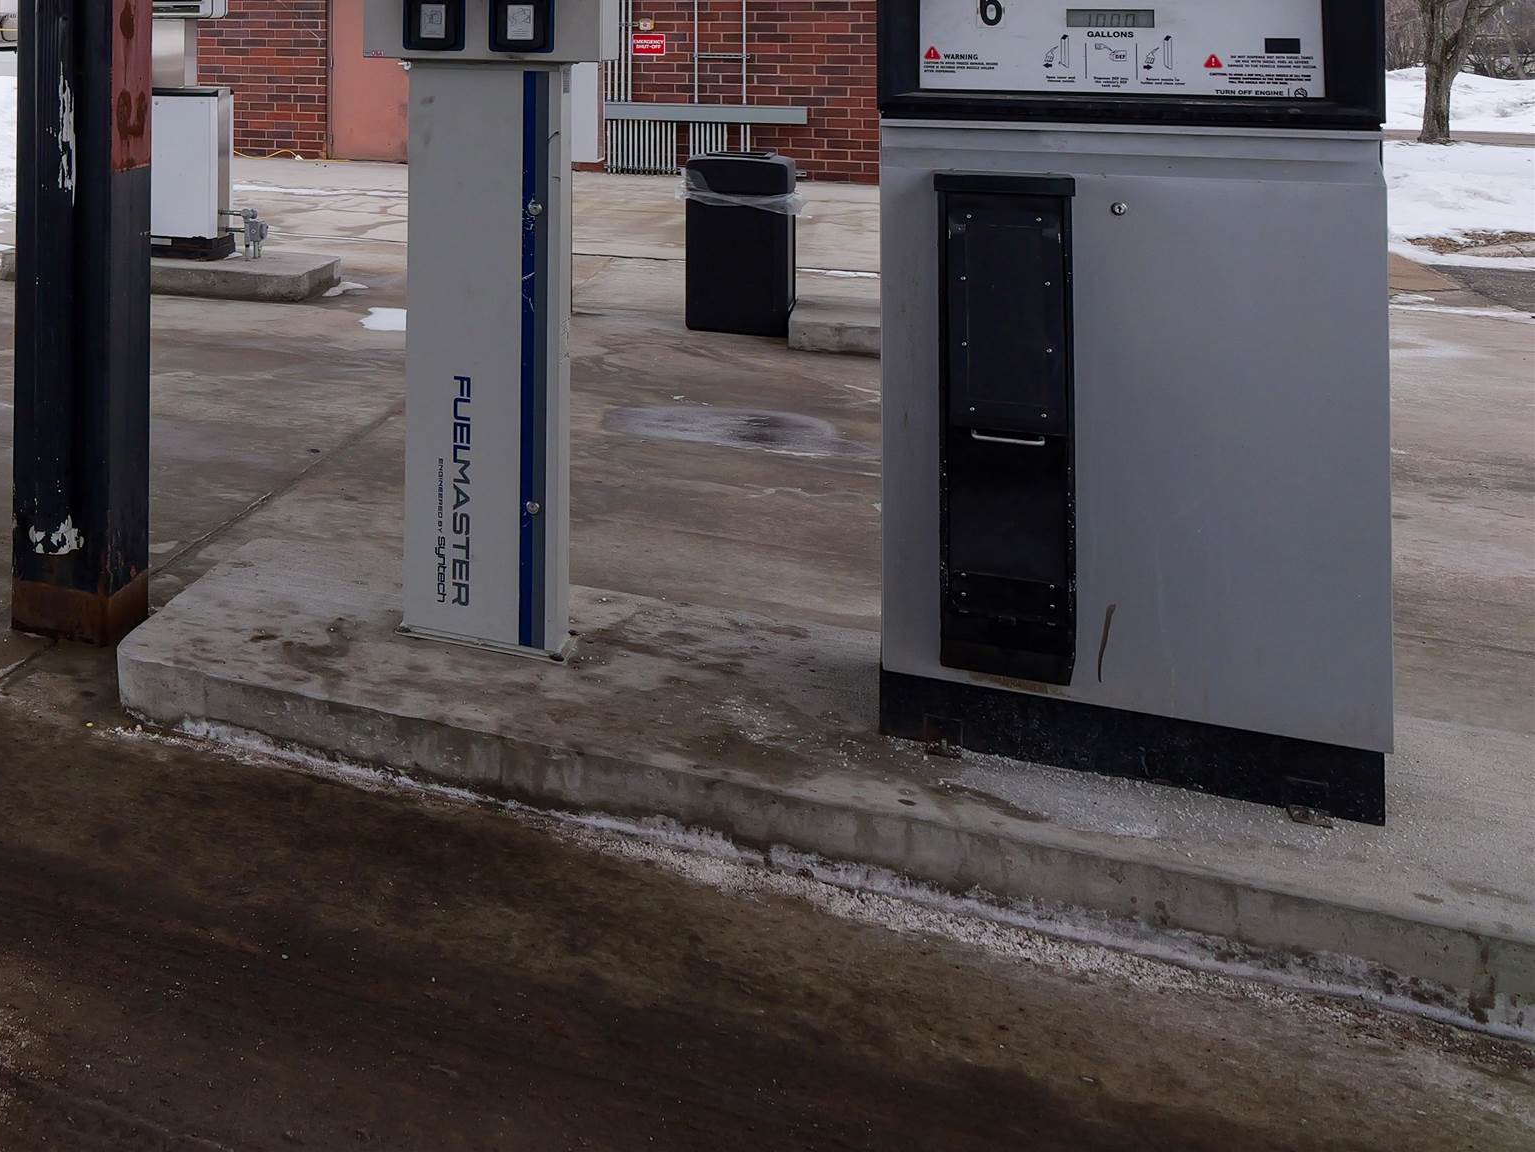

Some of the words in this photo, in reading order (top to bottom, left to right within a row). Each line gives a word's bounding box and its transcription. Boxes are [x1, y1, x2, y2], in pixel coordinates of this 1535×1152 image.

[436, 458, 444, 519] ENGINEERED
[451, 375, 471, 607] FUELMASTER
[437, 520, 443, 533] BY
